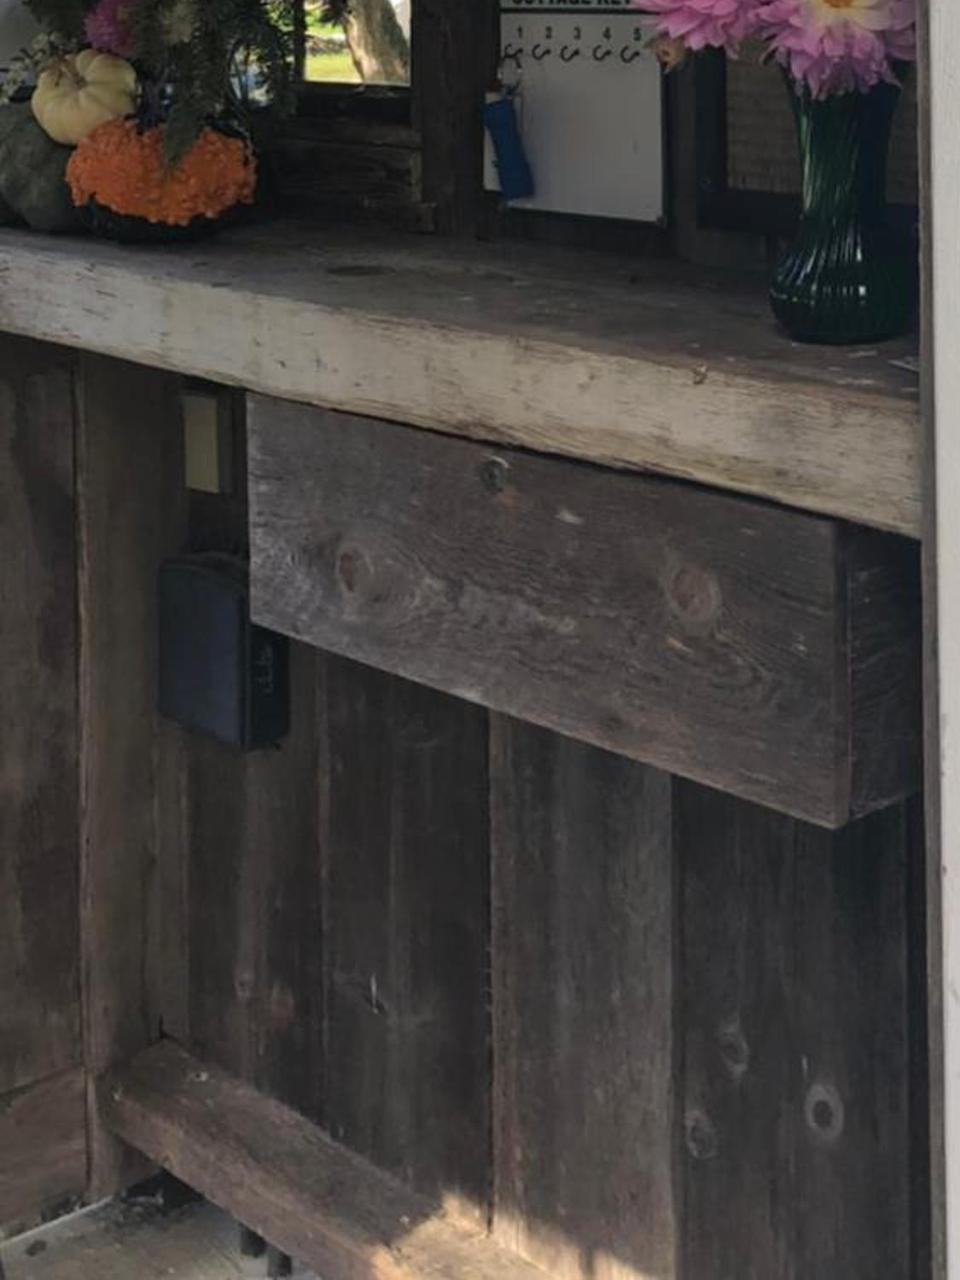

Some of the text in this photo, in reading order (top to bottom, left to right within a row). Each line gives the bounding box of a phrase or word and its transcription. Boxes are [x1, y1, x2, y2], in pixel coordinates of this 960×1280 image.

[517, 25, 642, 41] 1 2 3 4 5
